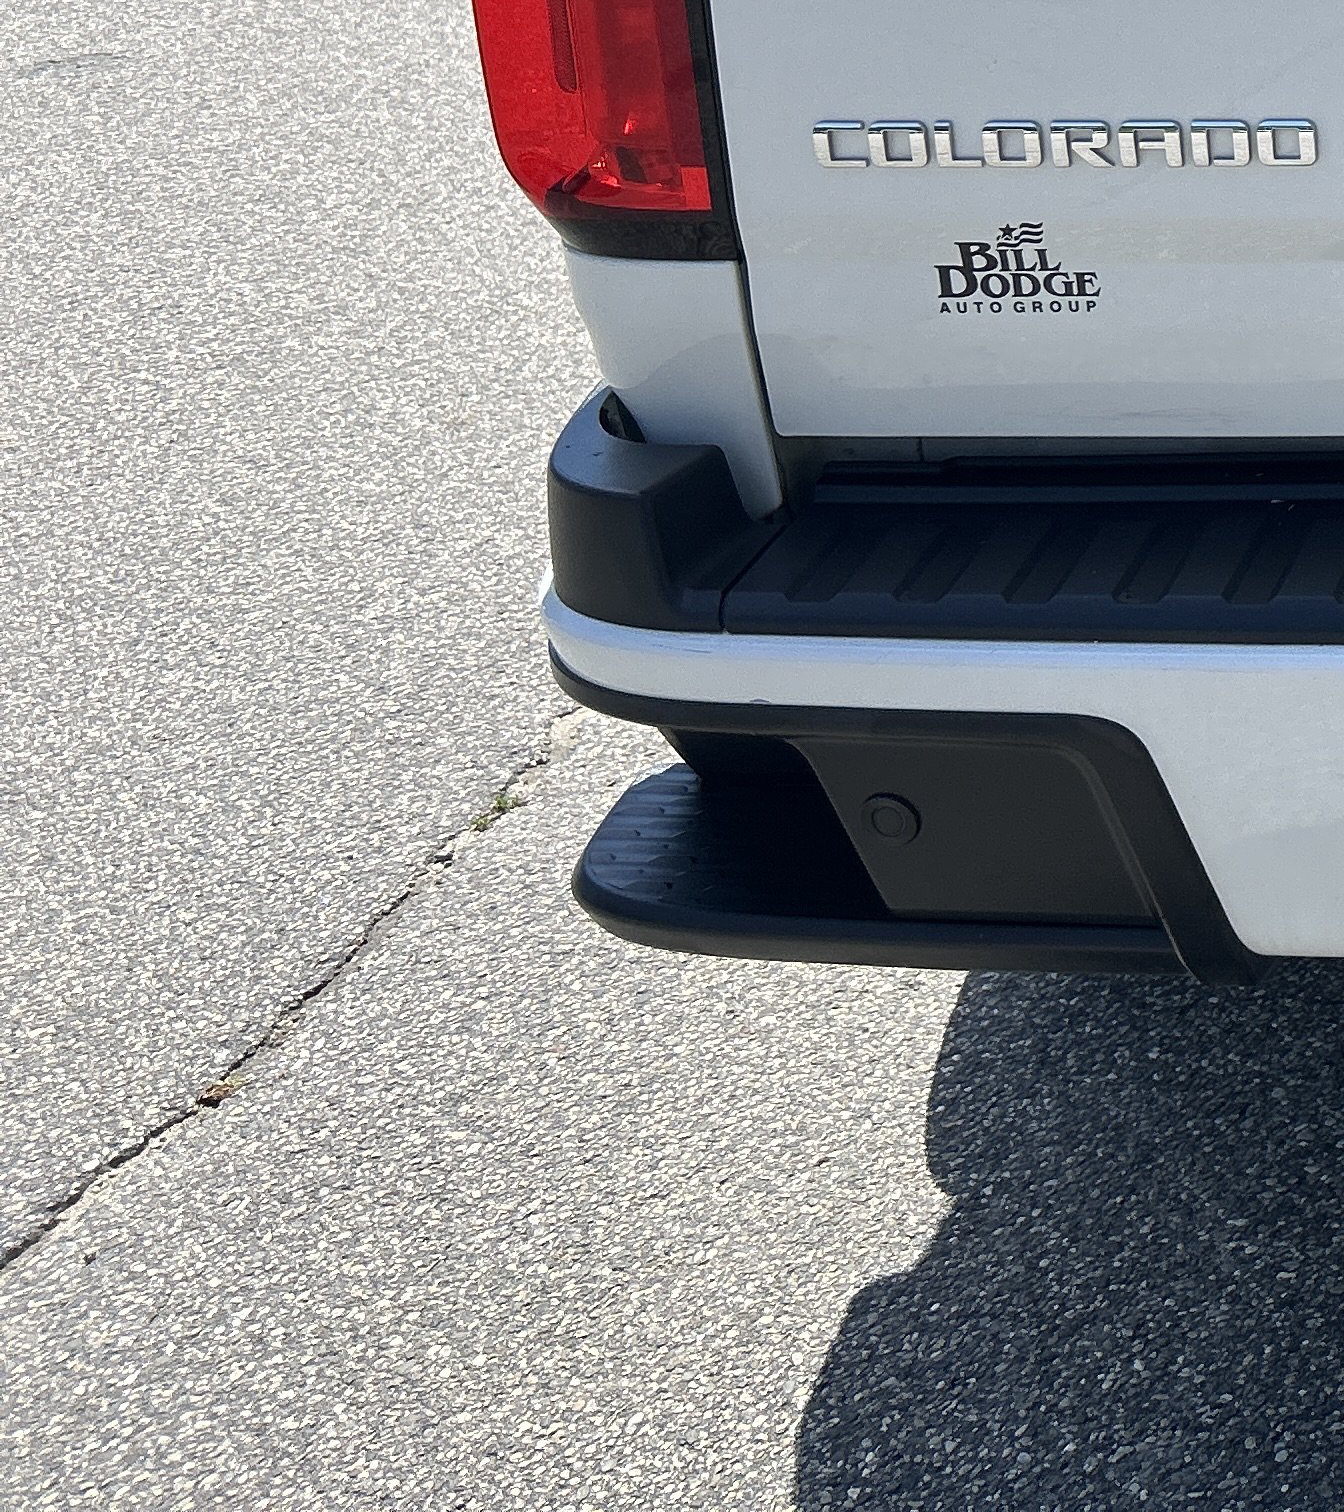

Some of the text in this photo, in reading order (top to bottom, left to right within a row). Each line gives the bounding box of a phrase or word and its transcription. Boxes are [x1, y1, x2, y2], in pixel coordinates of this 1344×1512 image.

[812, 119, 1320, 168] COLORADO
[954, 241, 1062, 273] BILL
[934, 265, 1101, 299] DODGE
[940, 300, 1097, 314] AUTO GROUP
